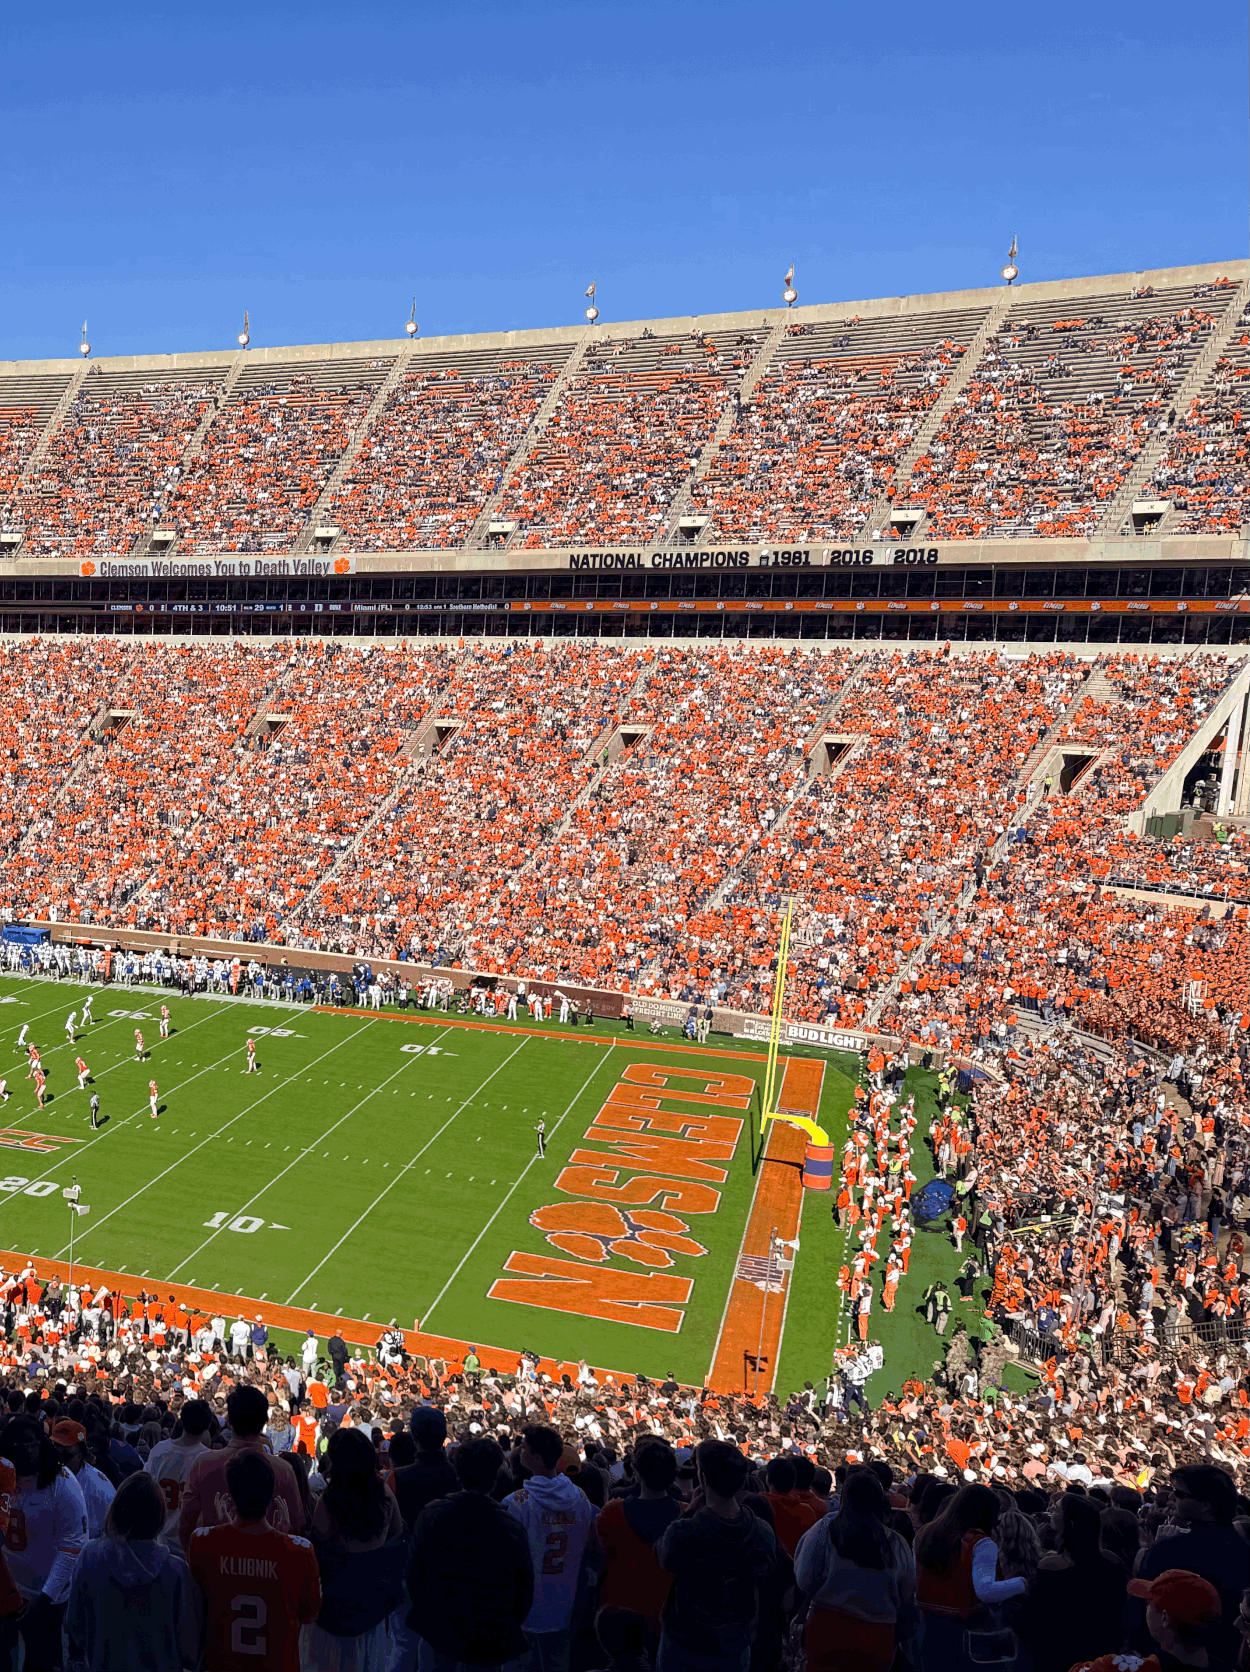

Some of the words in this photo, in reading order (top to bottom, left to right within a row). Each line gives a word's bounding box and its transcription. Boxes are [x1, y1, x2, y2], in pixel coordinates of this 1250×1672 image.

[569, 553, 645, 569] NATIONAL
[651, 551, 750, 568] CHAMPIONS
[772, 550, 811, 566] 1981
[830, 549, 874, 565] 2016
[893, 548, 938, 564] 2018
[100, 561, 149, 576] Clemson
[151, 561, 212, 576] Welcomes
[214, 561, 235, 576] You
[238, 561, 250, 575] to
[254, 560, 289, 575] Death
[293, 559, 331, 577] Valley
[215, 604, 237, 612] 10:51
[632, 1000, 649, 1010] OLD
[650, 1002, 687, 1015] DOMINION
[634, 1006, 665, 1018] FREIGHT
[666, 1011, 684, 1020] LINE
[246, 1026, 296, 1037] 20
[788, 1026, 818, 1042] BUD
[819, 1030, 864, 1049] LIGHT
[400, 1044, 444, 1055] 10
[202, 1211, 266, 1234] 10
[542, 1532, 567, 1574] 2
[219, 1555, 279, 1580] KLUBNIK
[229, 1594, 268, 1656] 2
